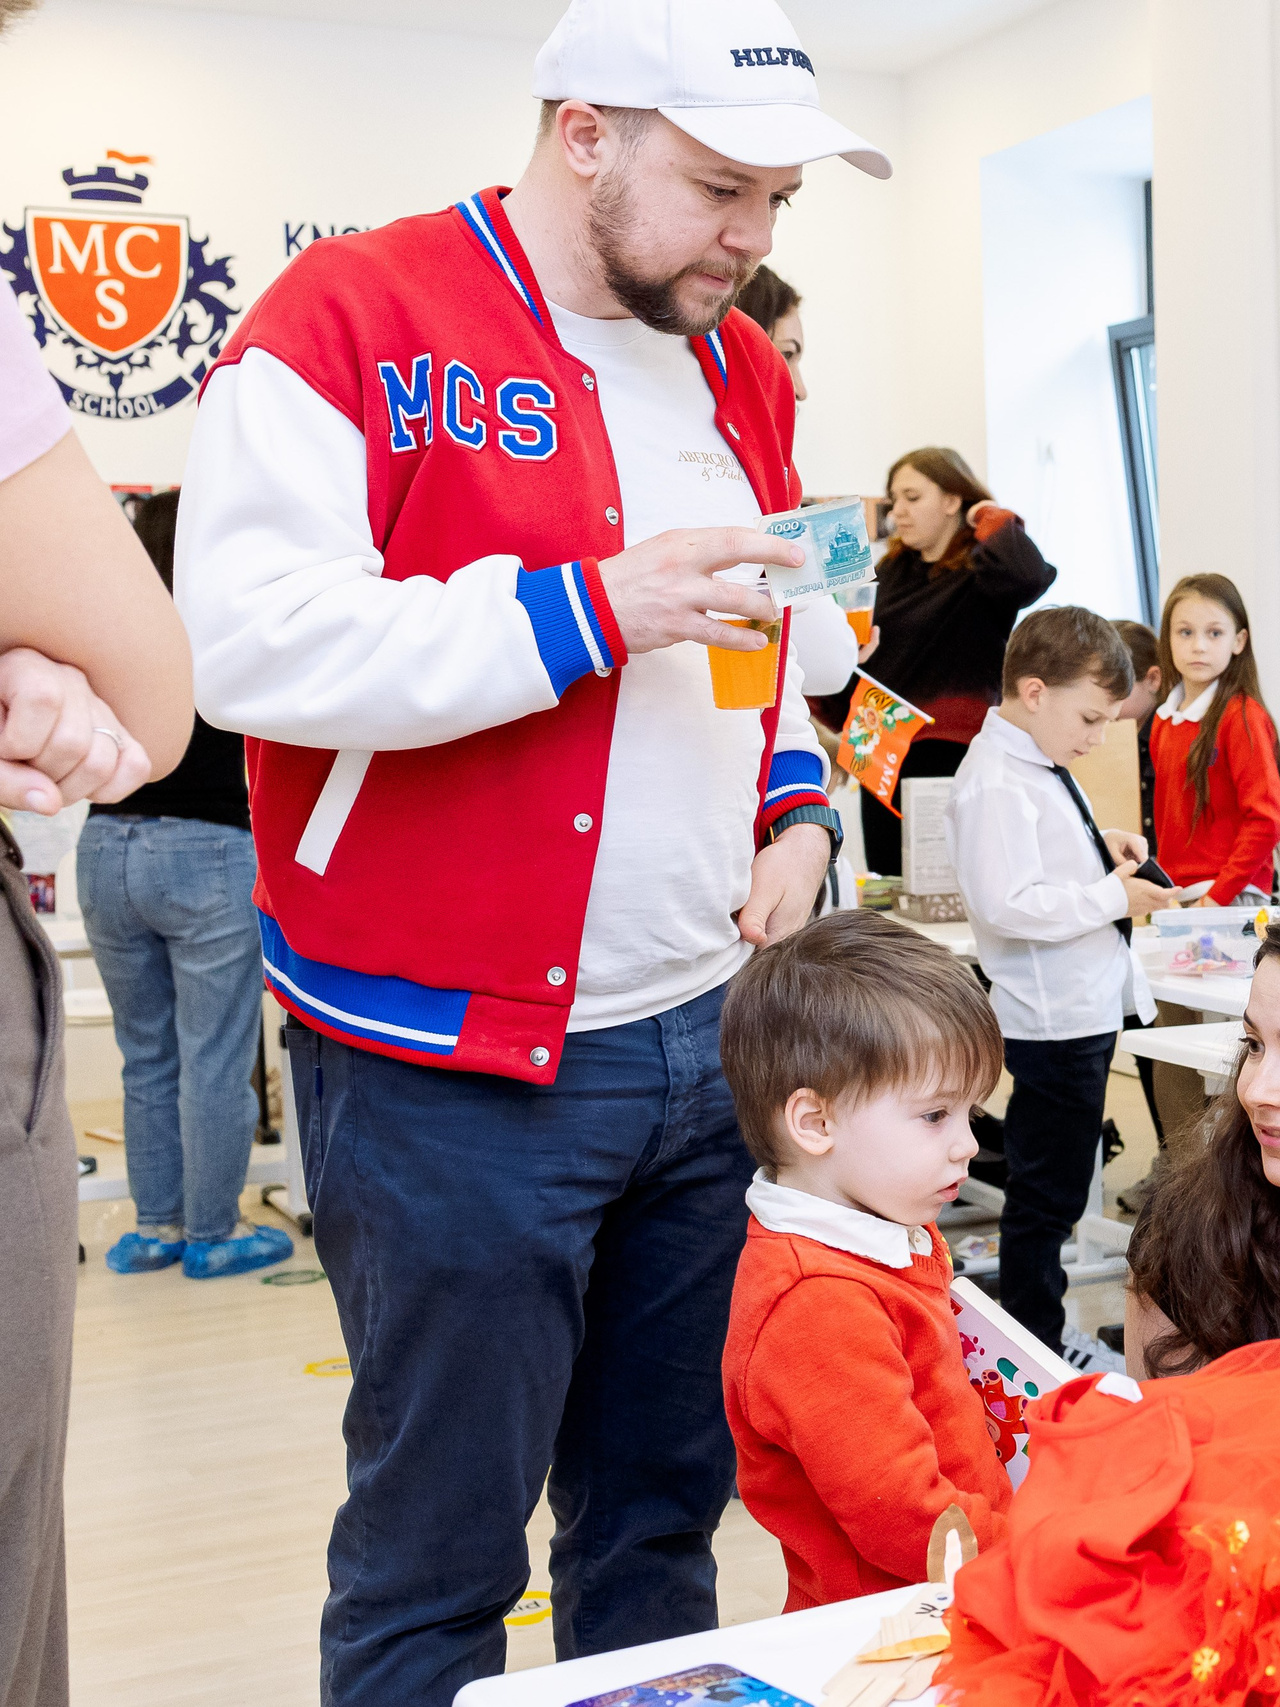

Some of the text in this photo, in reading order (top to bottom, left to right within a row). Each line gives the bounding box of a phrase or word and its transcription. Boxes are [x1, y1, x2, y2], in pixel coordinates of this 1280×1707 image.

[730, 47, 815, 77] HILFIG
[48, 221, 163, 279] MC
[95, 278, 129, 330] S
[69, 389, 166, 419] SCHOOL
[377, 352, 558, 461] MCS
[702, 464, 748, 484] & Fitch
[769, 520, 800, 534] 1000
[783, 569, 866, 599] ТЫСЯЧА РУБЛЕЙ
[886, 752, 898, 765] 9
